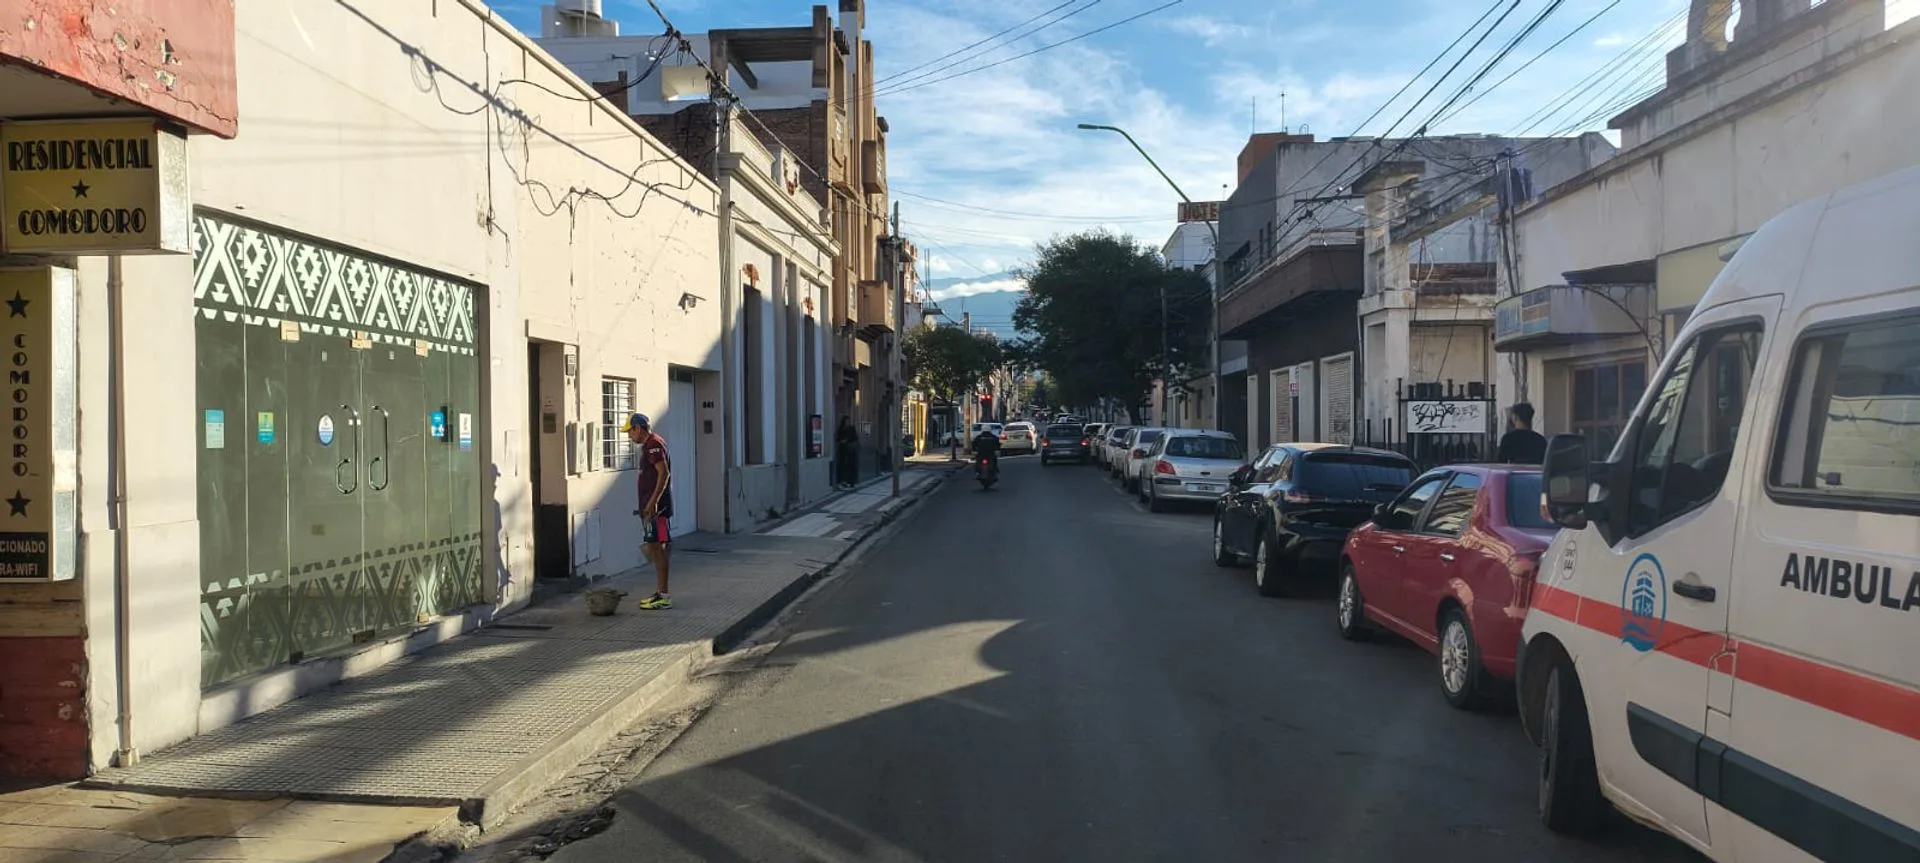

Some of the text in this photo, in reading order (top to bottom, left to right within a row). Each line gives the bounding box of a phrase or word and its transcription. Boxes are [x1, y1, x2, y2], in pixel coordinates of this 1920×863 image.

[8, 139, 153, 171] RESIDENCIAL
[18, 208, 147, 235] COMODORO
[9, 333, 30, 477] COMODORO
[0, 540, 46, 553] CIONADO
[1781, 553, 1920, 611] AMBULA
